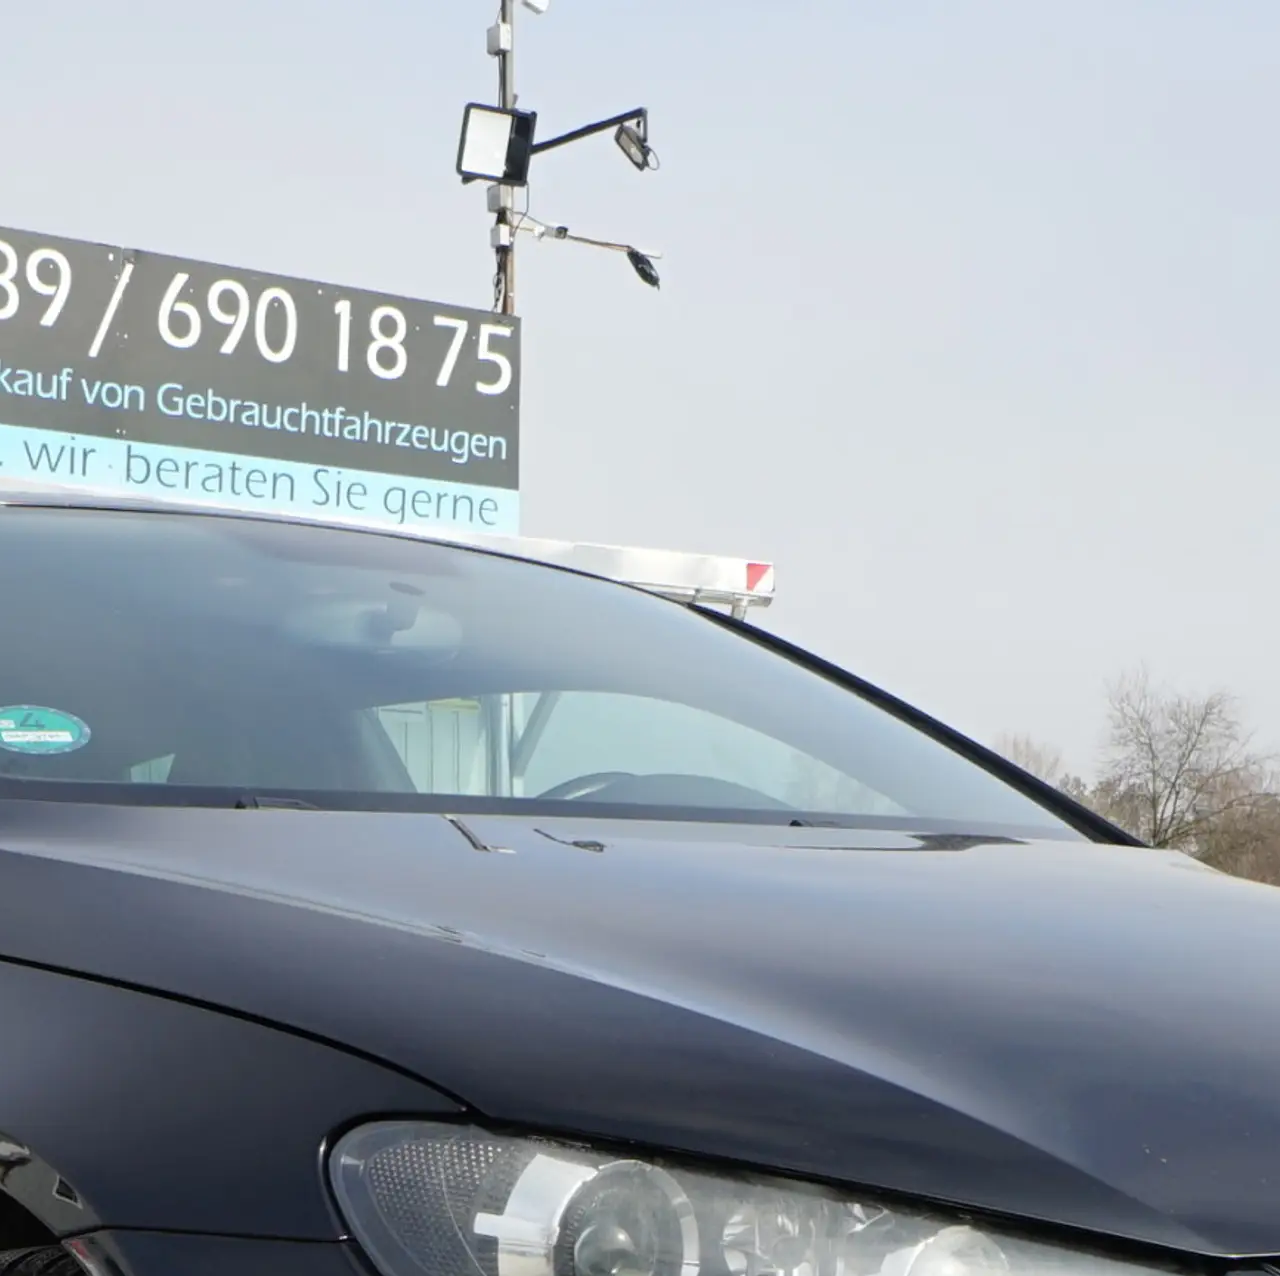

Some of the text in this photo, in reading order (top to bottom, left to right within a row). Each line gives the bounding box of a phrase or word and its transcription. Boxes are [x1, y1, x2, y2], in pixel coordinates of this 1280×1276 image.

[87, 262, 135, 358] /
[157, 273, 298, 364] 690
[333, 299, 408, 380] 18
[433, 315, 513, 395] 75
[80, 380, 145, 412] von
[157, 382, 508, 465] Gebrauchtfahrzeugen
[22, 436, 97, 479] wir
[125, 444, 296, 503] beraten
[312, 467, 368, 511] Sie
[383, 484, 500, 533] gerne
